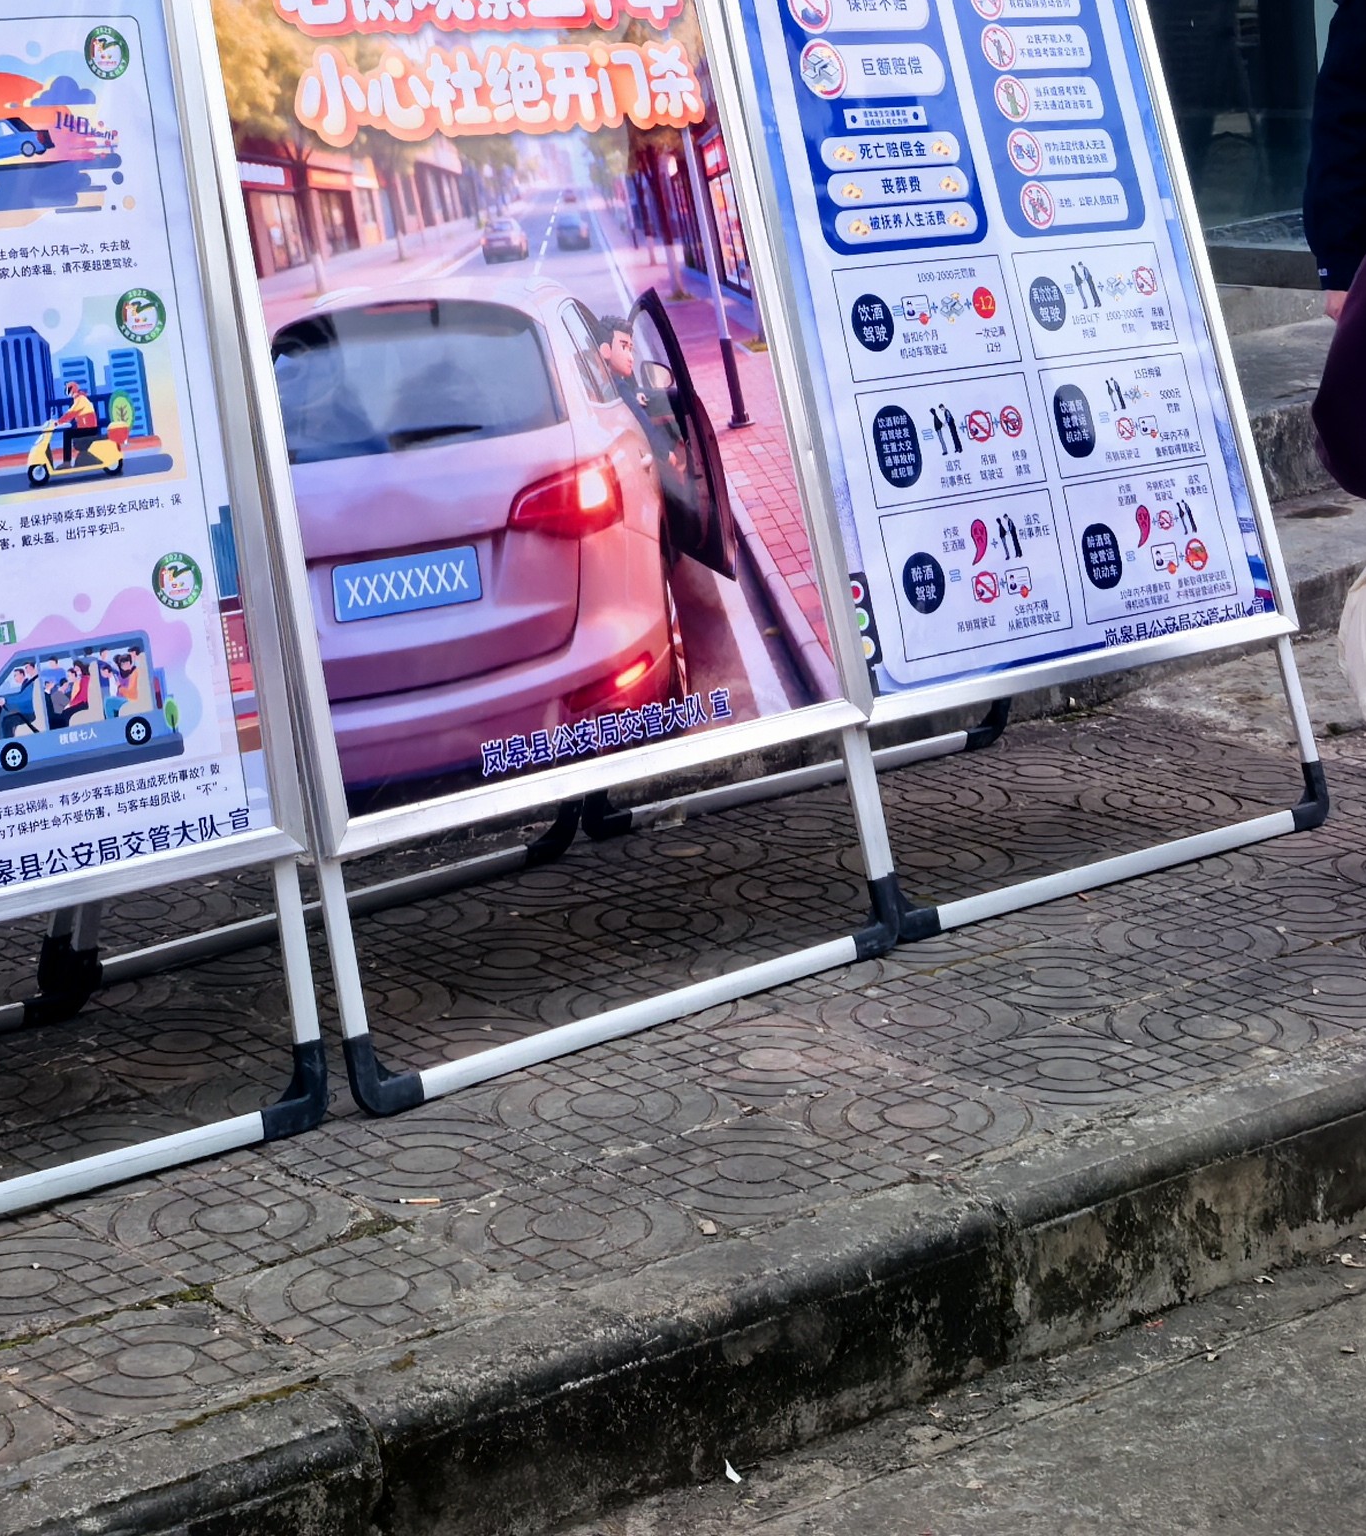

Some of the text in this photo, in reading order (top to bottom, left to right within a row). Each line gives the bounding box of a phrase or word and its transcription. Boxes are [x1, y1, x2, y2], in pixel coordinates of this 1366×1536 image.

[861, 56, 923, 76] 巨额赔偿
[302, 46, 699, 137] 小心杜绝开门杀
[858, 141, 927, 160] 死亡赔偿金
[881, 175, 922, 194] 丧葬费
[869, 210, 947, 230] 被抚养人生活费
[858, 304, 884, 321] 饮酒
[1039, 306, 1063, 323] 驾驶
[863, 324, 888, 343] 驾驶
[1065, 429, 1091, 444] 机动车
[940, 473, 973, 489] 刑事责任
[910, 564, 934, 583] 醉酒
[1092, 564, 1119, 580] 机动车
[344, 560, 469, 609] XXXXXXX
[914, 584, 938, 602] 驾驶
[481, 688, 732, 777] 岚皋县公安局交管大队 宣
[228, 808, 252, 831] 宣
